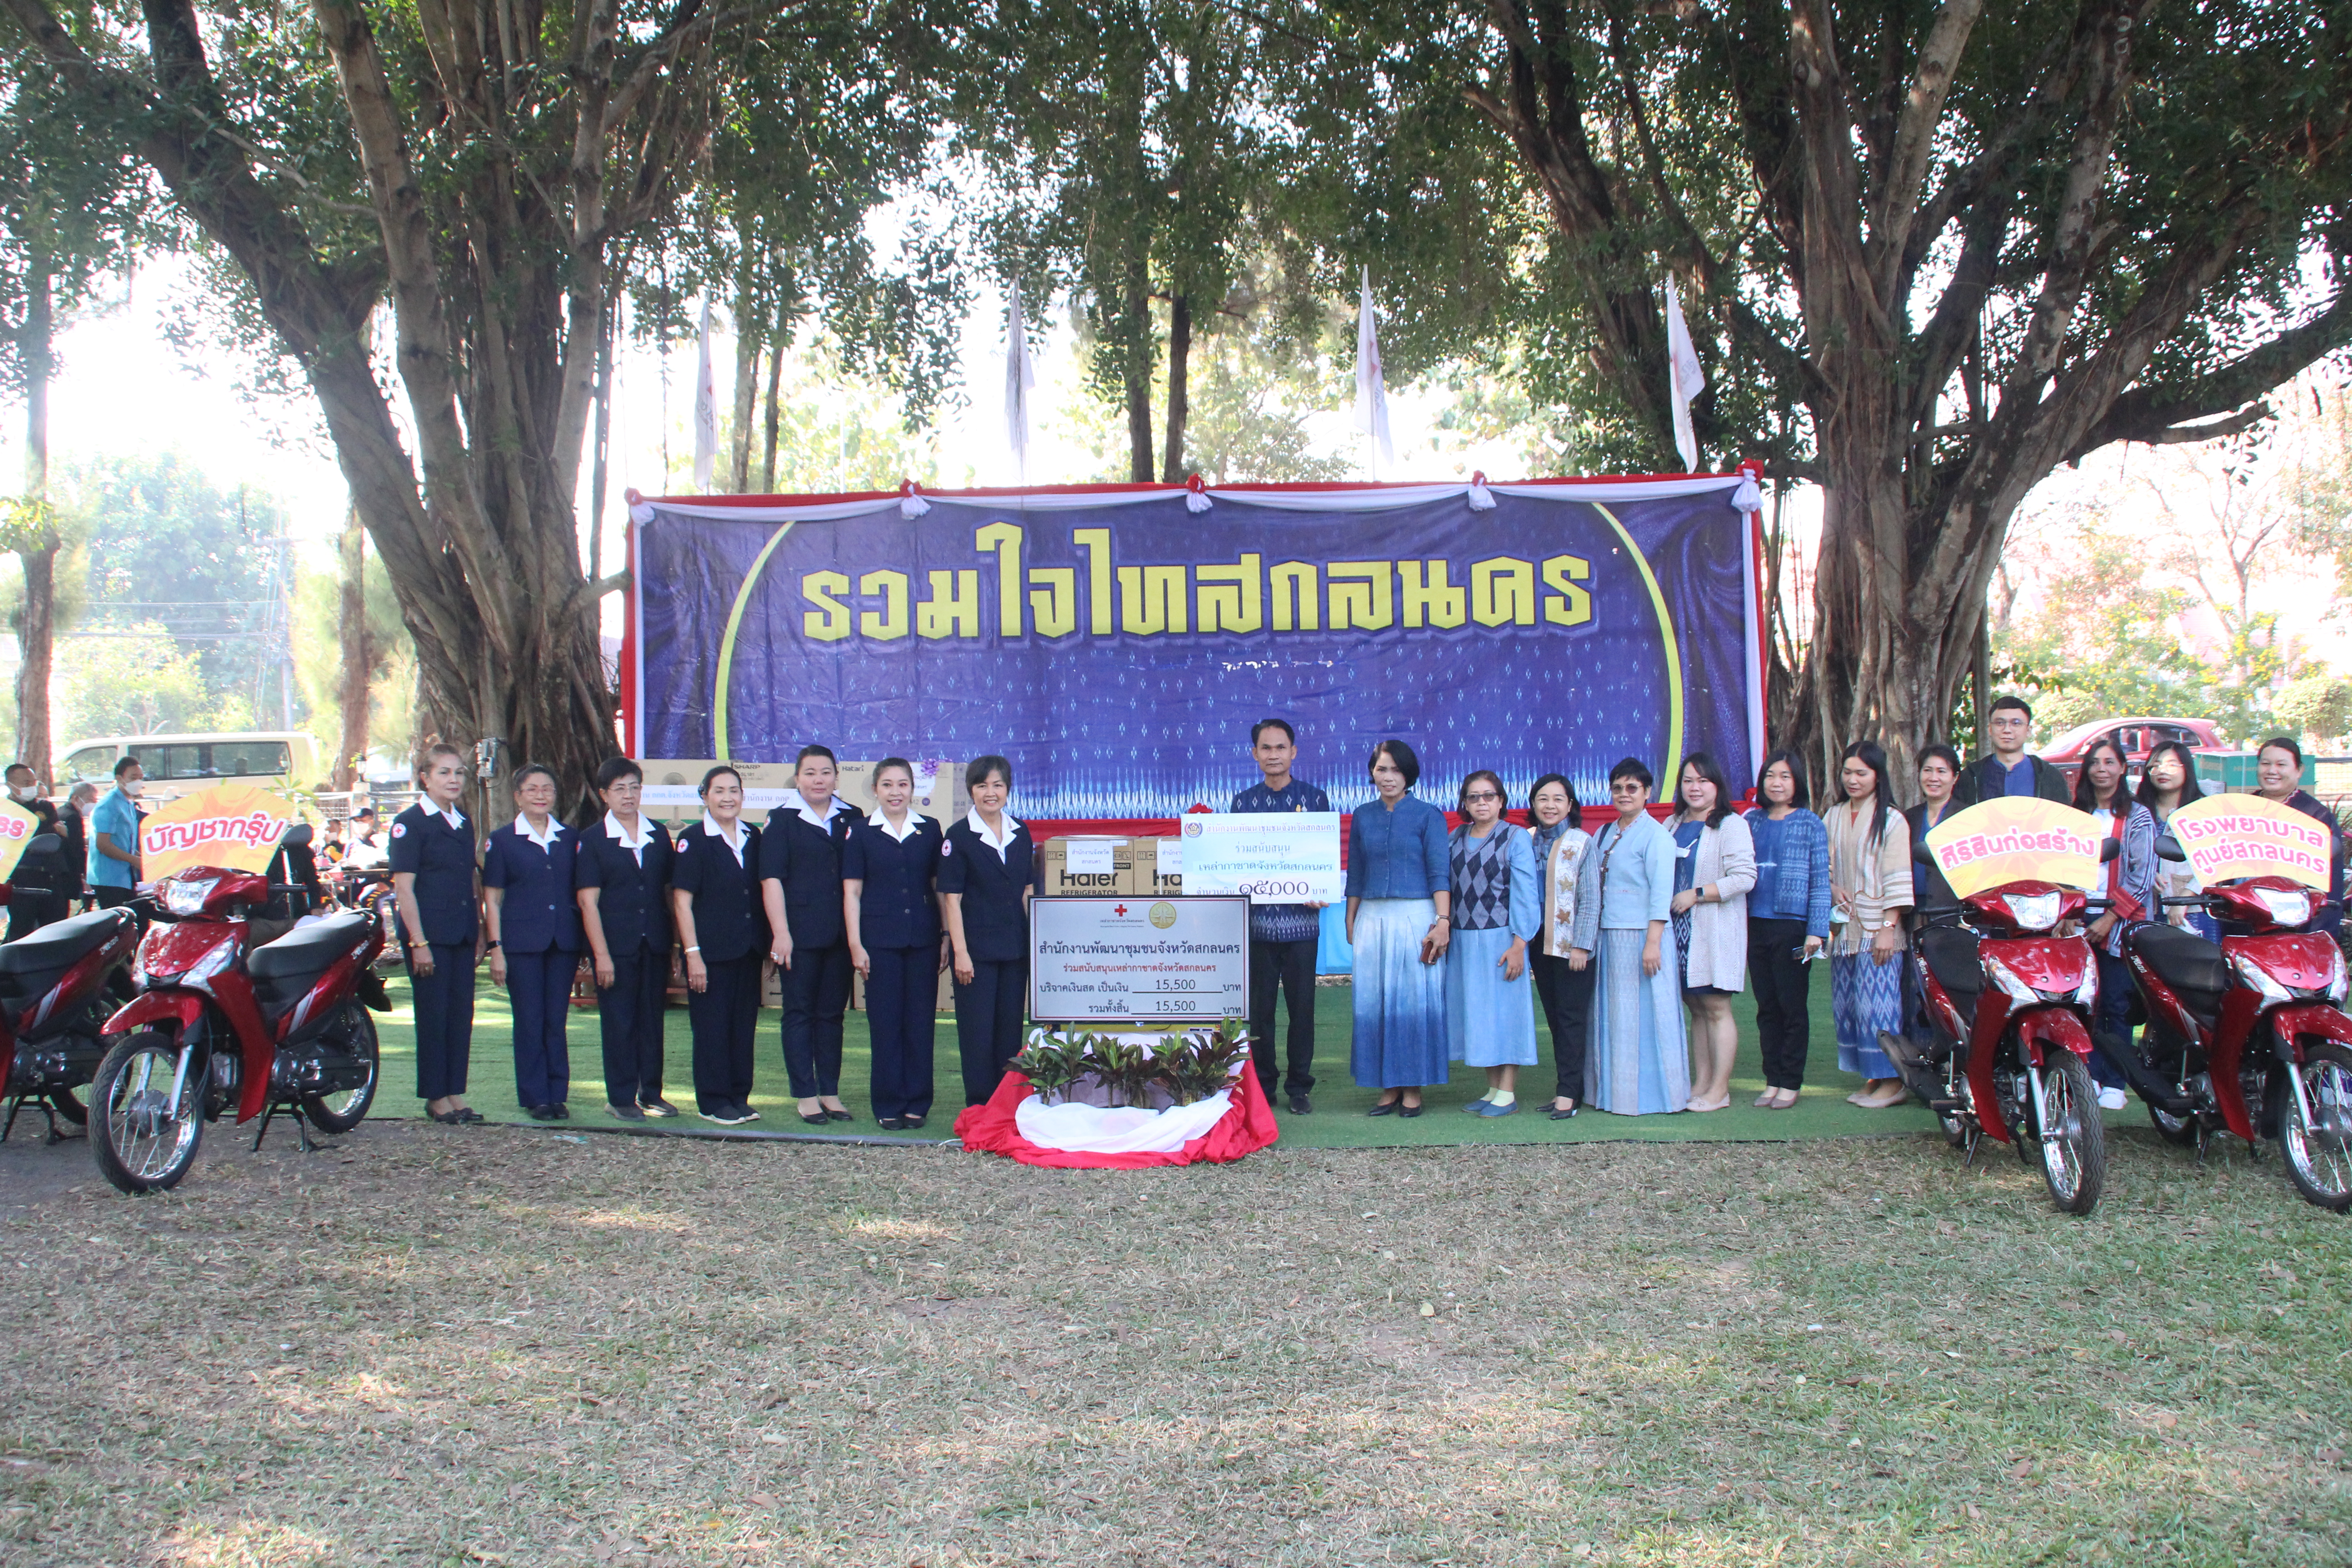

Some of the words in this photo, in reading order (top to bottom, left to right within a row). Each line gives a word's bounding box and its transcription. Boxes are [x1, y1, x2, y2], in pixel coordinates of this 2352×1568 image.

[802, 522, 1591, 641] รวมใจไทสกลนคร
[147, 813, 284, 853] บัญชากรุ๊ป
[1206, 822, 1336, 836] สำนักงานพัฒนาชุมชนจังหวัดสกลนคร
[2176, 817, 2323, 848] โรงพยาบาล
[1235, 842, 1290, 856] ร่วมสนับสนุน
[2192, 838, 2326, 874] ศูนย์สกลนคร
[1199, 861, 1333, 871] เหล่ากาชาดจังหวัดสกลนคร
[1060, 869, 1118, 886] Haier
[1039, 941, 1240, 958] สำนักงานพัฒนาชุมชนจังหวัดสกลนคร
[1063, 962, 1216, 975] ร่วมสนับสนุนเหล่ากาชาดจังหวัดสกลนคร
[1040, 981, 1095, 993] บริจาคเงินสด
[1098, 981, 1129, 993] เป็นเงิน
[1156, 979, 1196, 991] 15,500
[1223, 983, 1241, 992] บาท
[1088, 999, 1129, 1013] รวมทั้งสิ้น
[1156, 1000, 1196, 1013] 15,500
[1223, 1005, 1241, 1015] บาท
